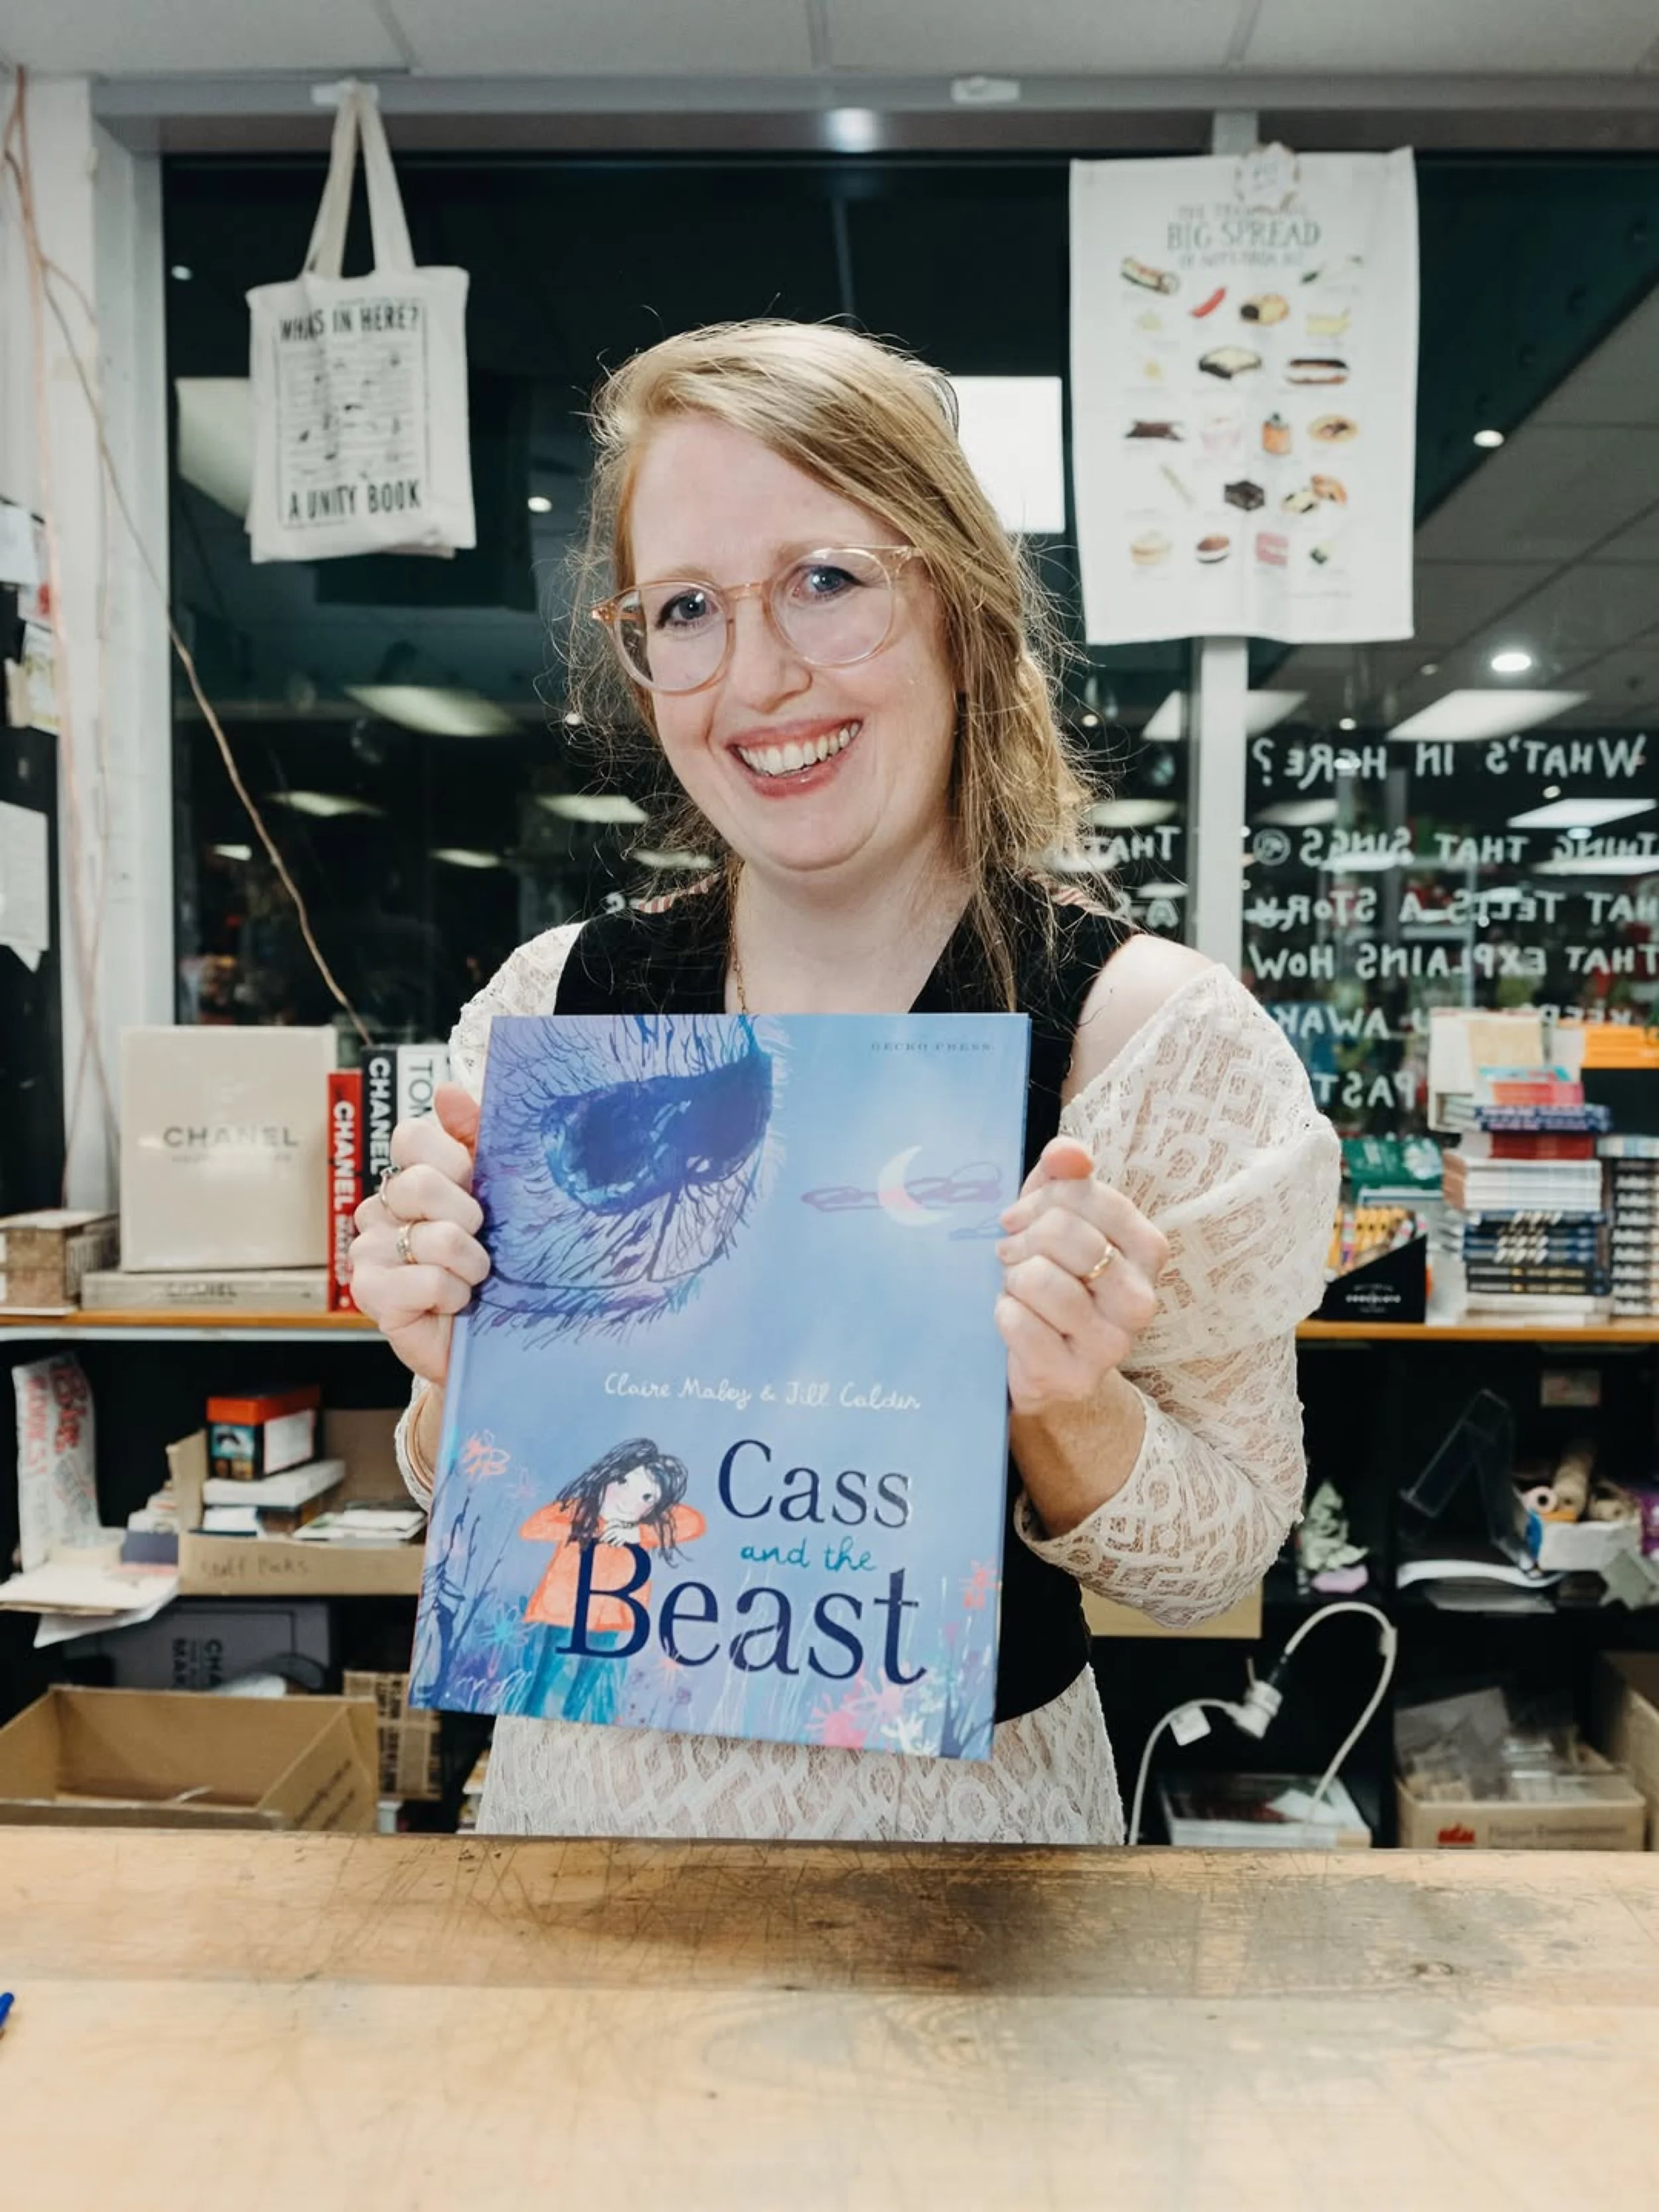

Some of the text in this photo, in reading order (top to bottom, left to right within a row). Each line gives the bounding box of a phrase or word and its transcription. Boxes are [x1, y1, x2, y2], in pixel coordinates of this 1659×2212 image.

[333, 309, 352, 333] IN
[288, 479, 421, 521] A UNITY BOOK
[367, 1056, 392, 1175] CHANEL
[163, 1126, 299, 1148] CHANEL
[333, 1100, 356, 1212] CHANEL
[605, 1372, 671, 1398] Claire
[786, 1381, 831, 1407] Jill
[717, 1439, 910, 1528] Cass
[740, 1536, 877, 1573] and the
[554, 1540, 927, 1686] Beast
